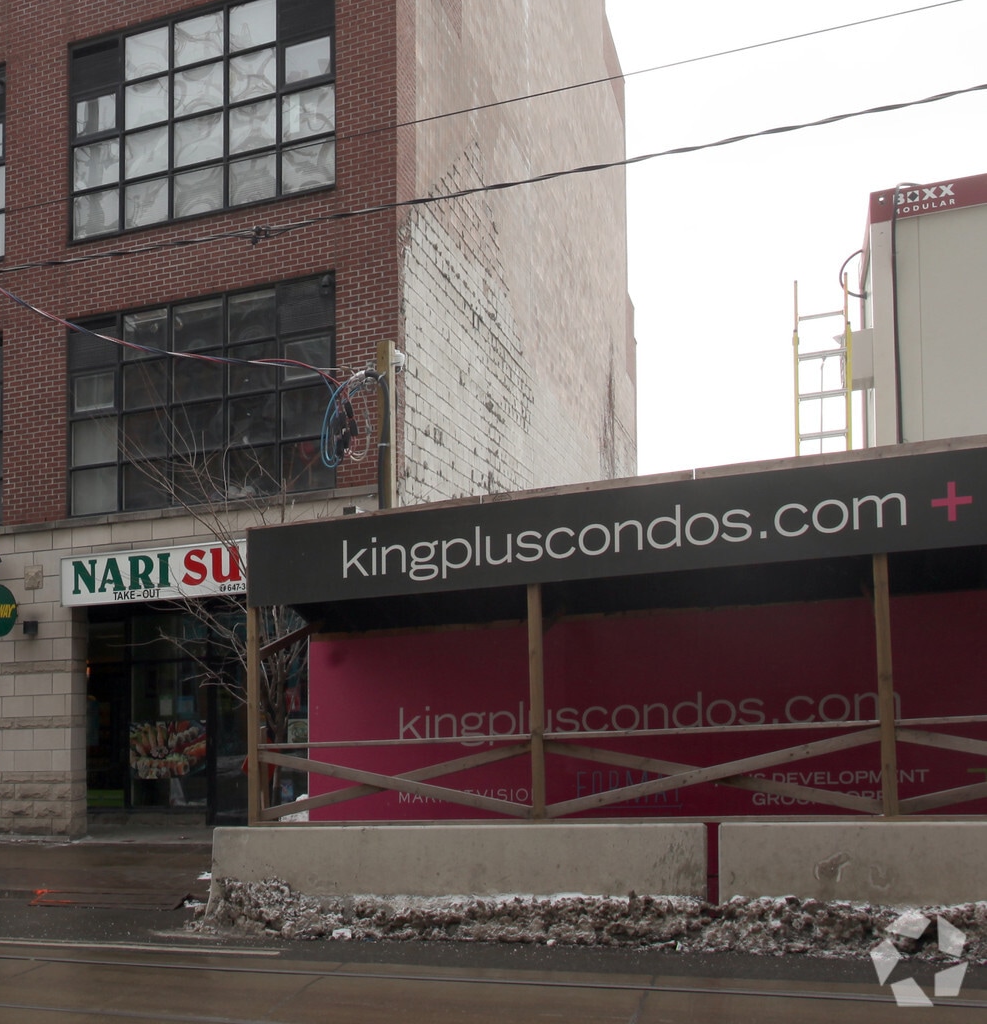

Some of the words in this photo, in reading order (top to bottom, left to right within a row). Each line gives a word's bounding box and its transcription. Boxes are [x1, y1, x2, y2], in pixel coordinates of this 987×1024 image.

[341, 491, 909, 582] kingpluscondos.com
[72, 553, 171, 595] NARI
[771, 769, 930, 786] DEVELOPMNT
